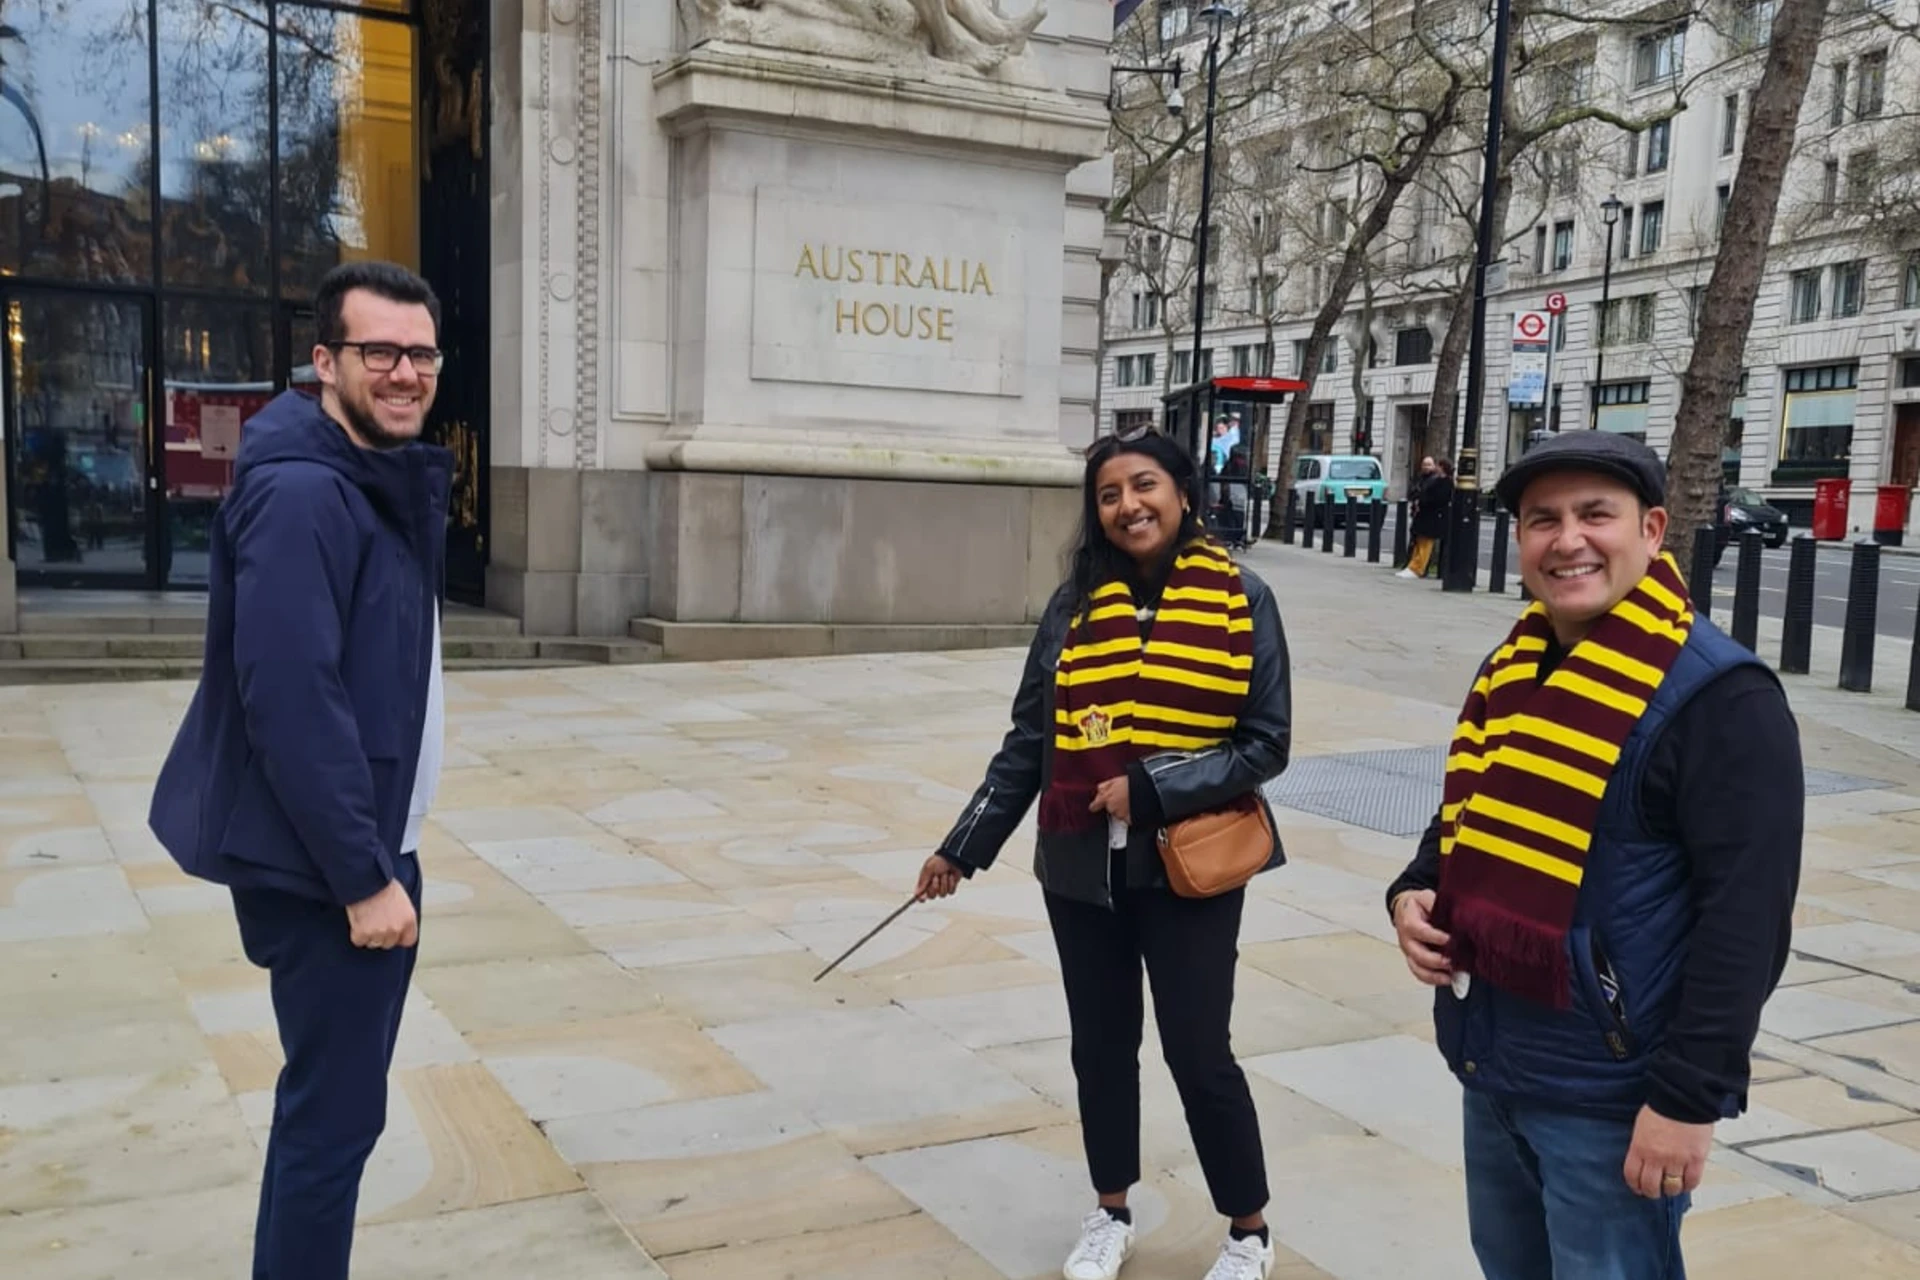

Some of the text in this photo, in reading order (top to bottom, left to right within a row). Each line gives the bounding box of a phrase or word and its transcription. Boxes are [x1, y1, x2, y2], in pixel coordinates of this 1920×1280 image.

[794, 243, 994, 296] AUSTRALIA
[836, 299, 954, 341] HOUSE
[1549, 294, 1562, 309] G
